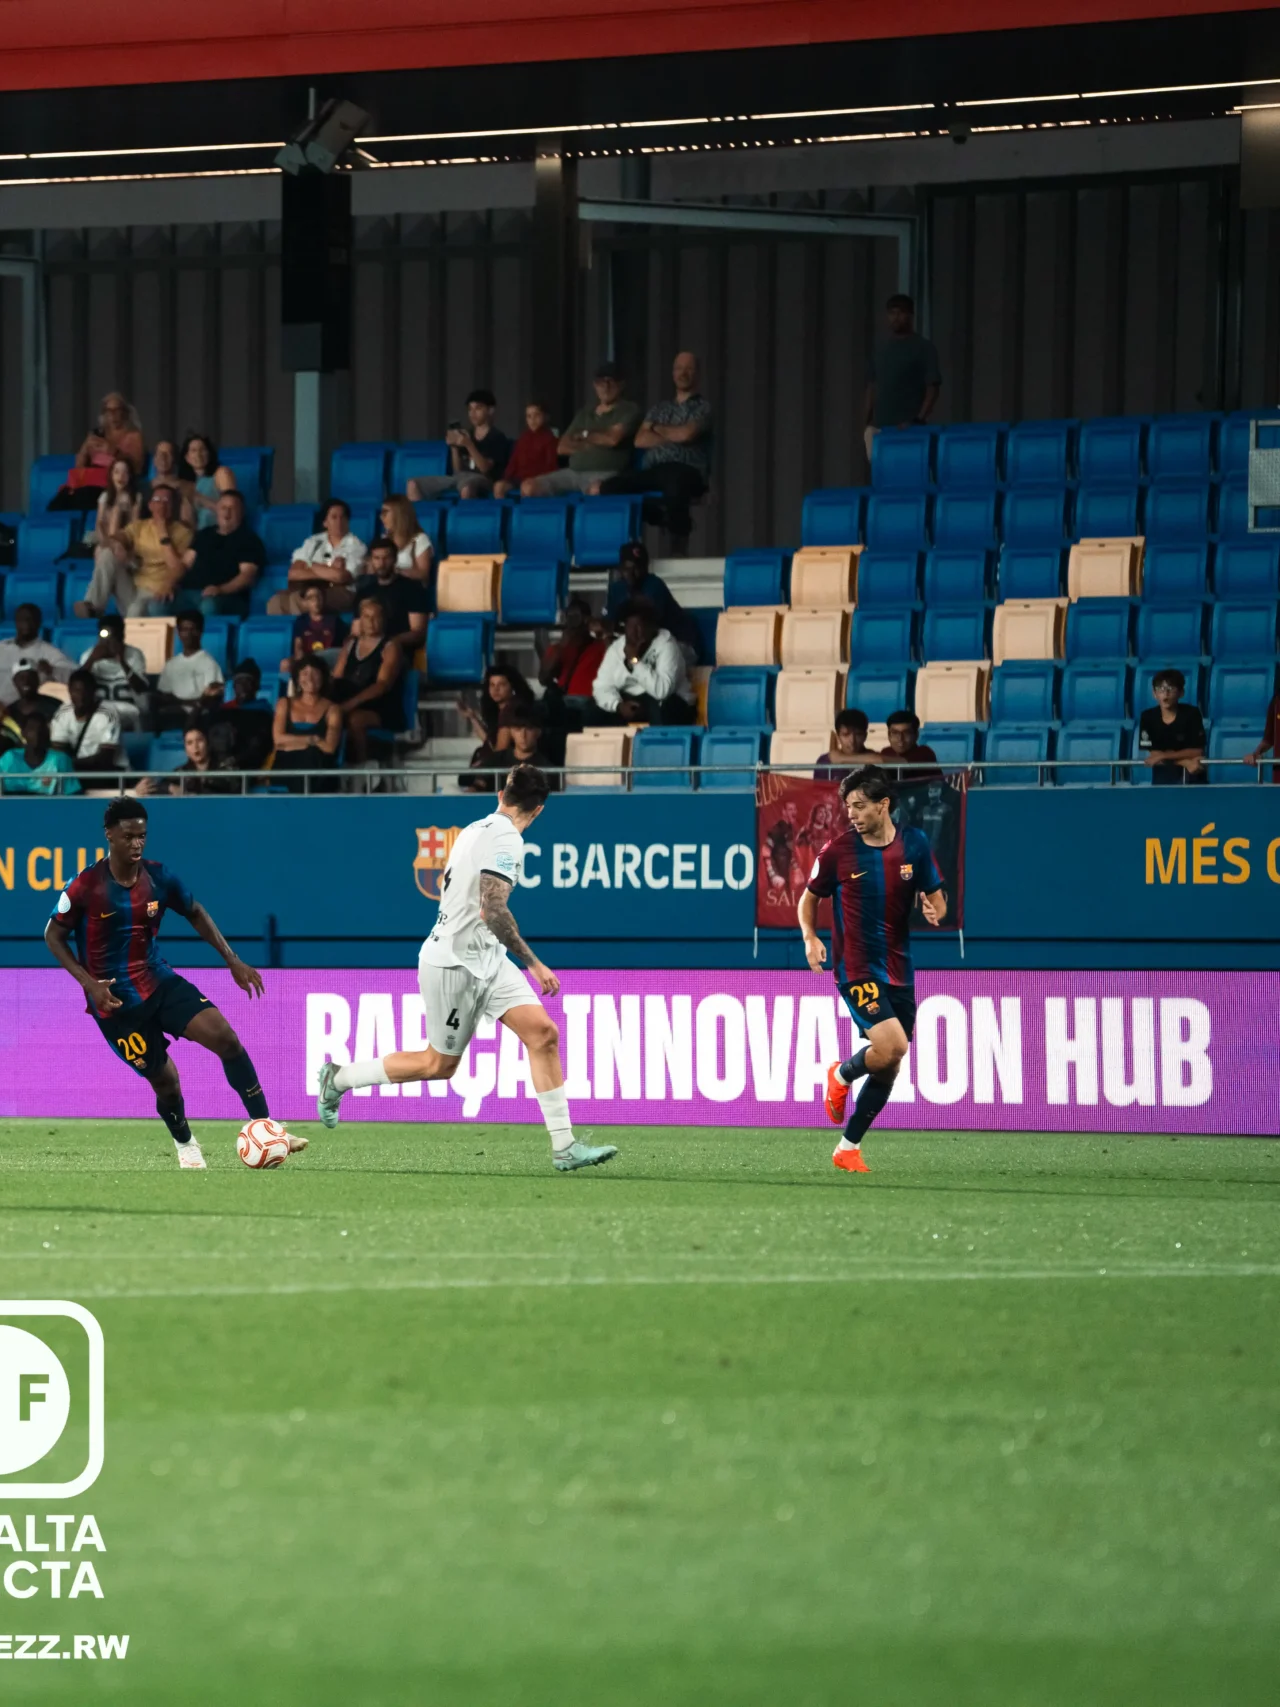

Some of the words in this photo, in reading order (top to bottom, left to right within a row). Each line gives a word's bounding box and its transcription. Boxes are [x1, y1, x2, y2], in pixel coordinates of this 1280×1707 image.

[27, 846, 105, 891] CL
[552, 843, 754, 890] BARCELO
[1145, 822, 1251, 885] MÉS
[850, 982, 880, 1008] 29
[446, 1008, 460, 1030] 4
[117, 1031, 147, 1061] 20
[1045, 996, 1213, 1107] HUB
